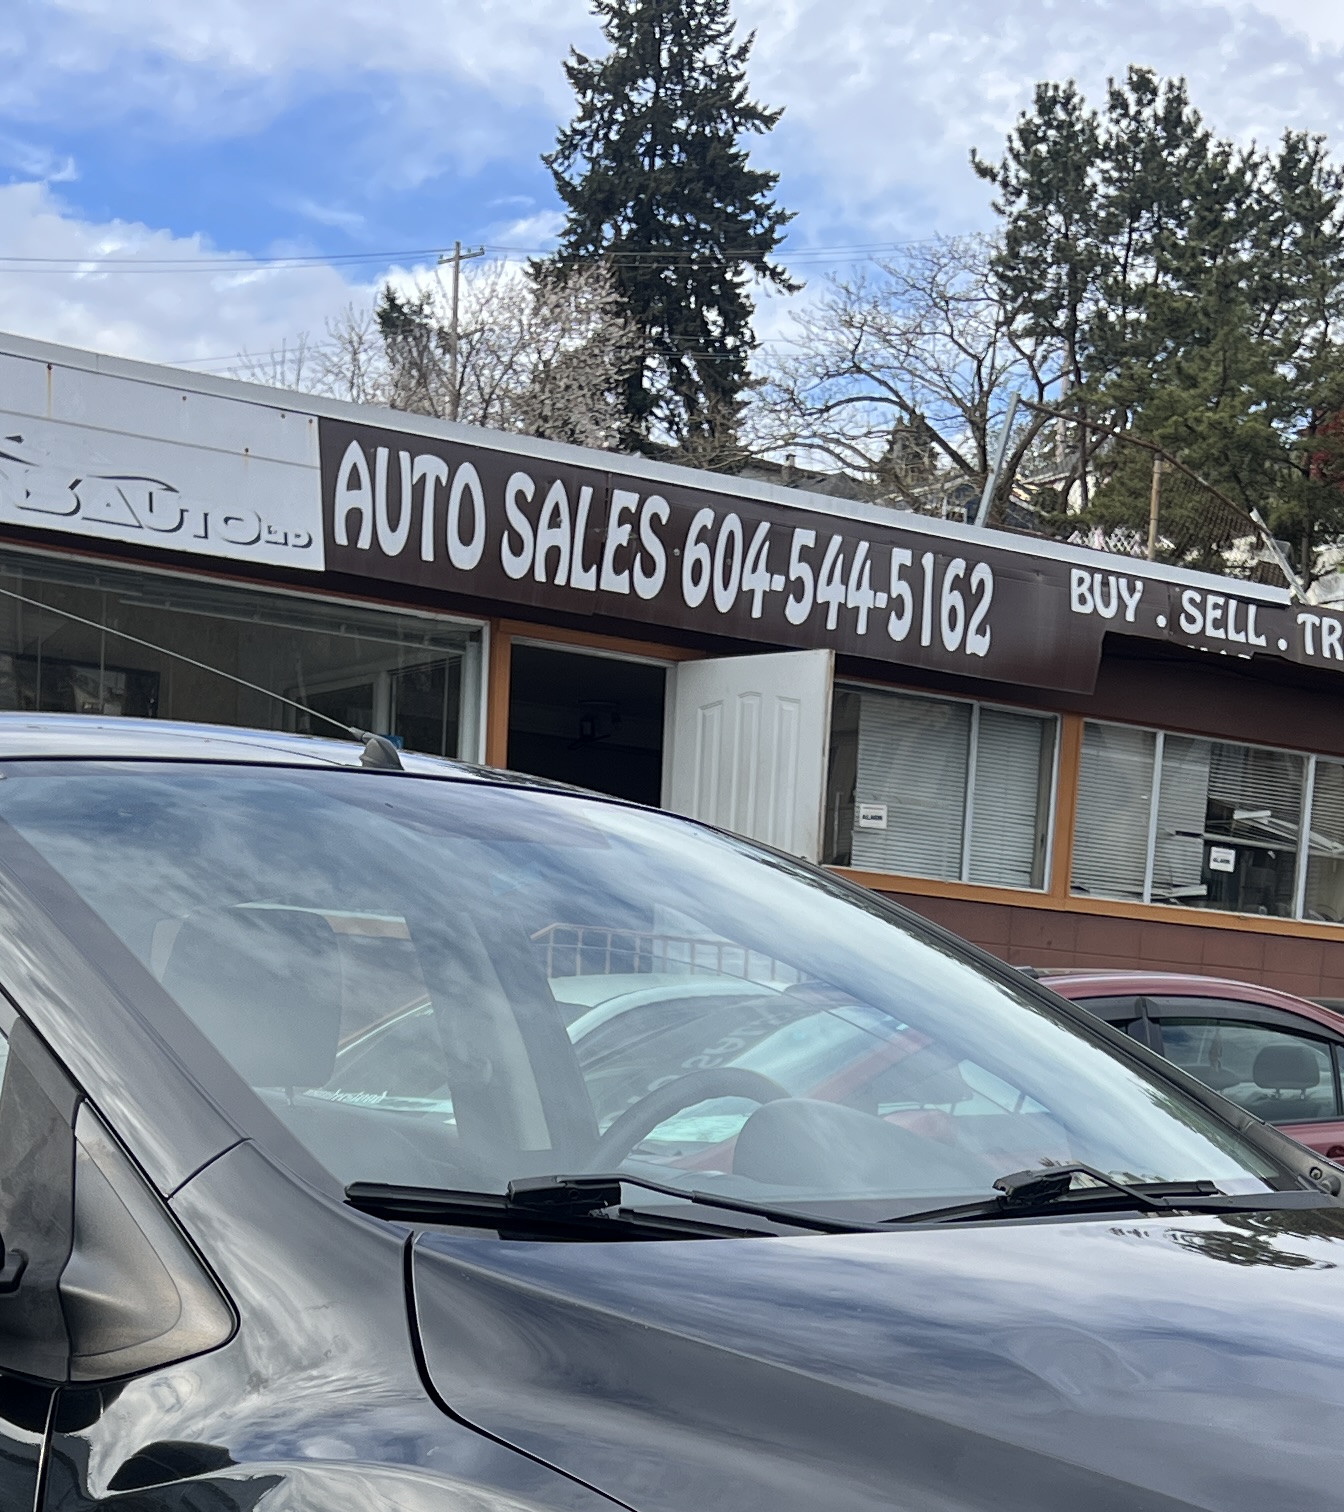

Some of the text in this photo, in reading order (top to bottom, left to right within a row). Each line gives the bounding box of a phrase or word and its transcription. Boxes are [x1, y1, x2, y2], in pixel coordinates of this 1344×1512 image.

[333, 440, 994, 656] AUTO SALES 604-544-5162
[1070, 568, 1143, 623] BUY
[1179, 589, 1267, 647] SELL
